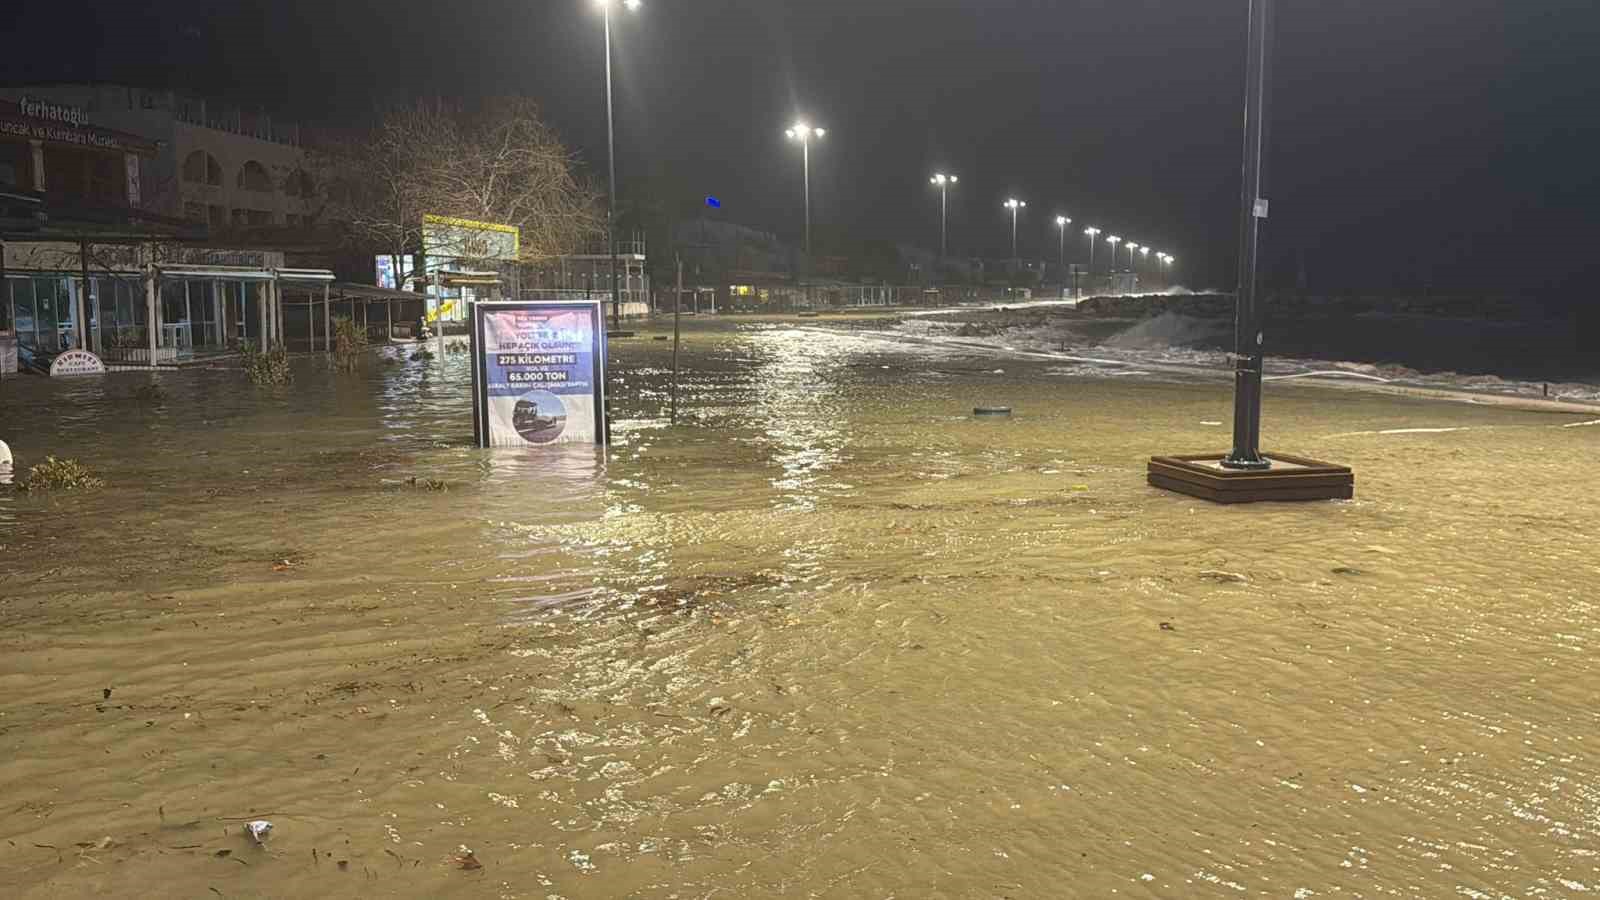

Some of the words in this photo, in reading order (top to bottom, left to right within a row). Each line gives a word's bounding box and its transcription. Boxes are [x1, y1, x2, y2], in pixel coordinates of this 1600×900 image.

[499, 356, 516, 364] 275
[509, 372, 543, 382] 65.000
[545, 371, 566, 381] TON
